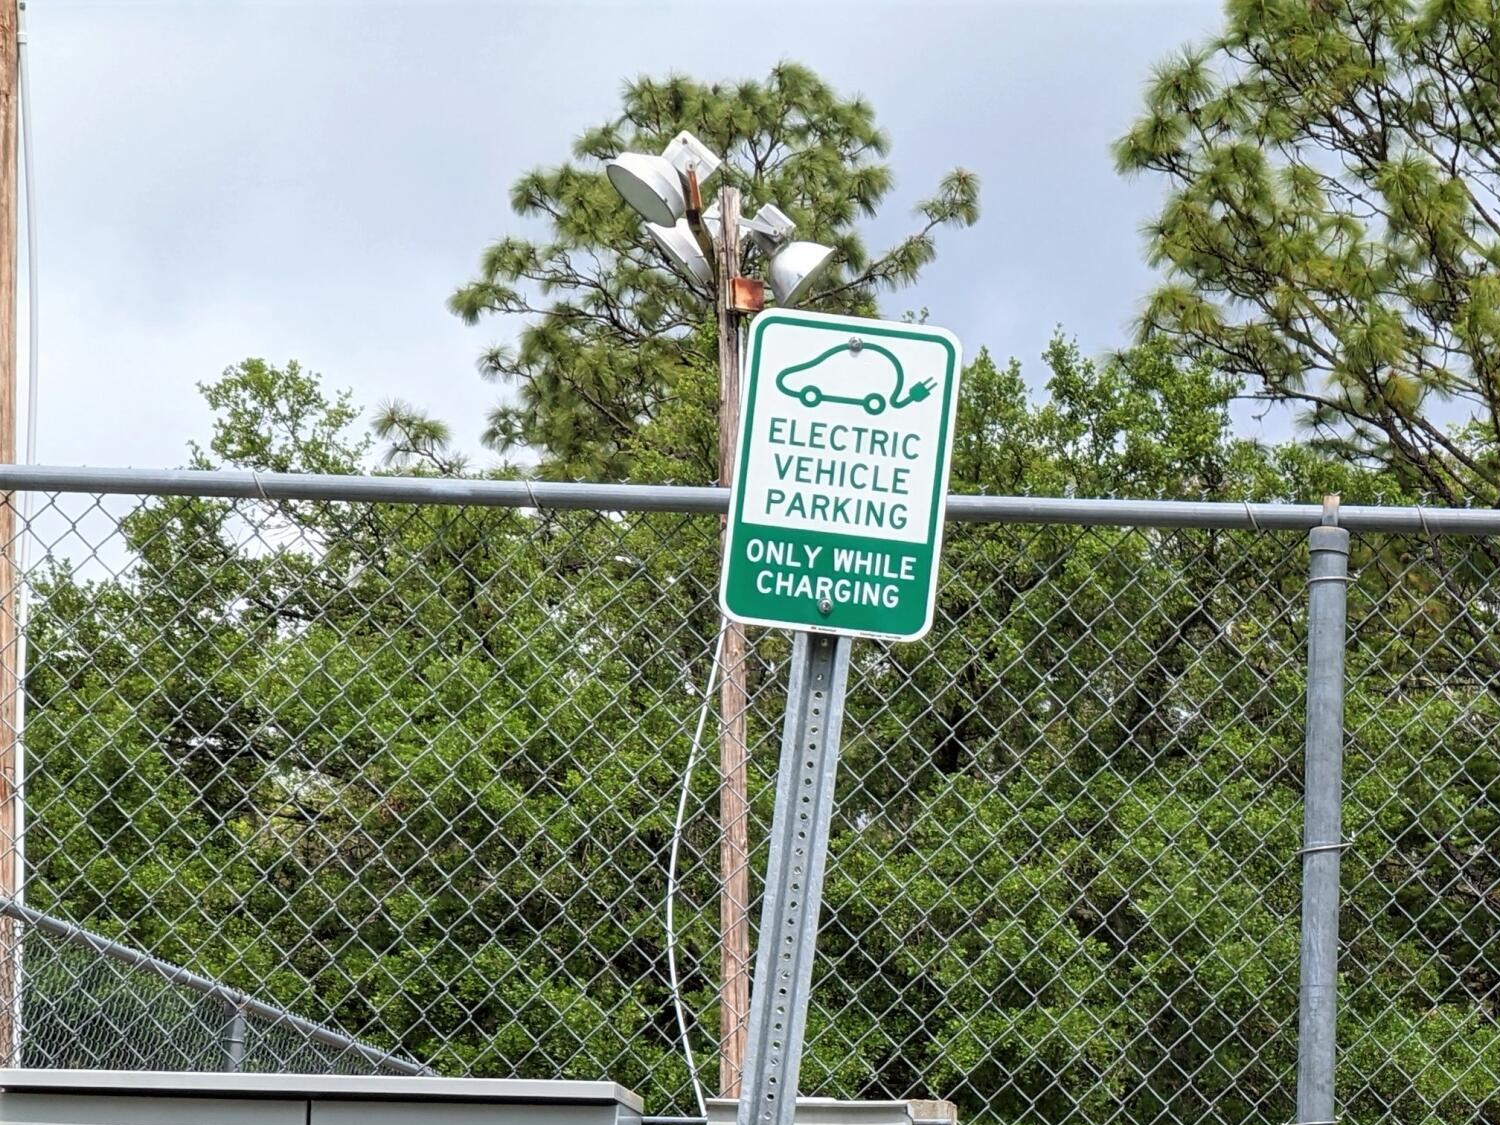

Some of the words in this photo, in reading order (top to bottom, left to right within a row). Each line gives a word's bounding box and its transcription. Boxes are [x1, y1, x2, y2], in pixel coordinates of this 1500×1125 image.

[768, 417, 921, 460] ELECTRIC
[774, 453, 910, 495] VEHICLE
[765, 488, 908, 530] PARKING
[746, 539, 823, 568] ONLY
[833, 547, 917, 580] WHILE
[756, 570, 900, 608] CHARGING
